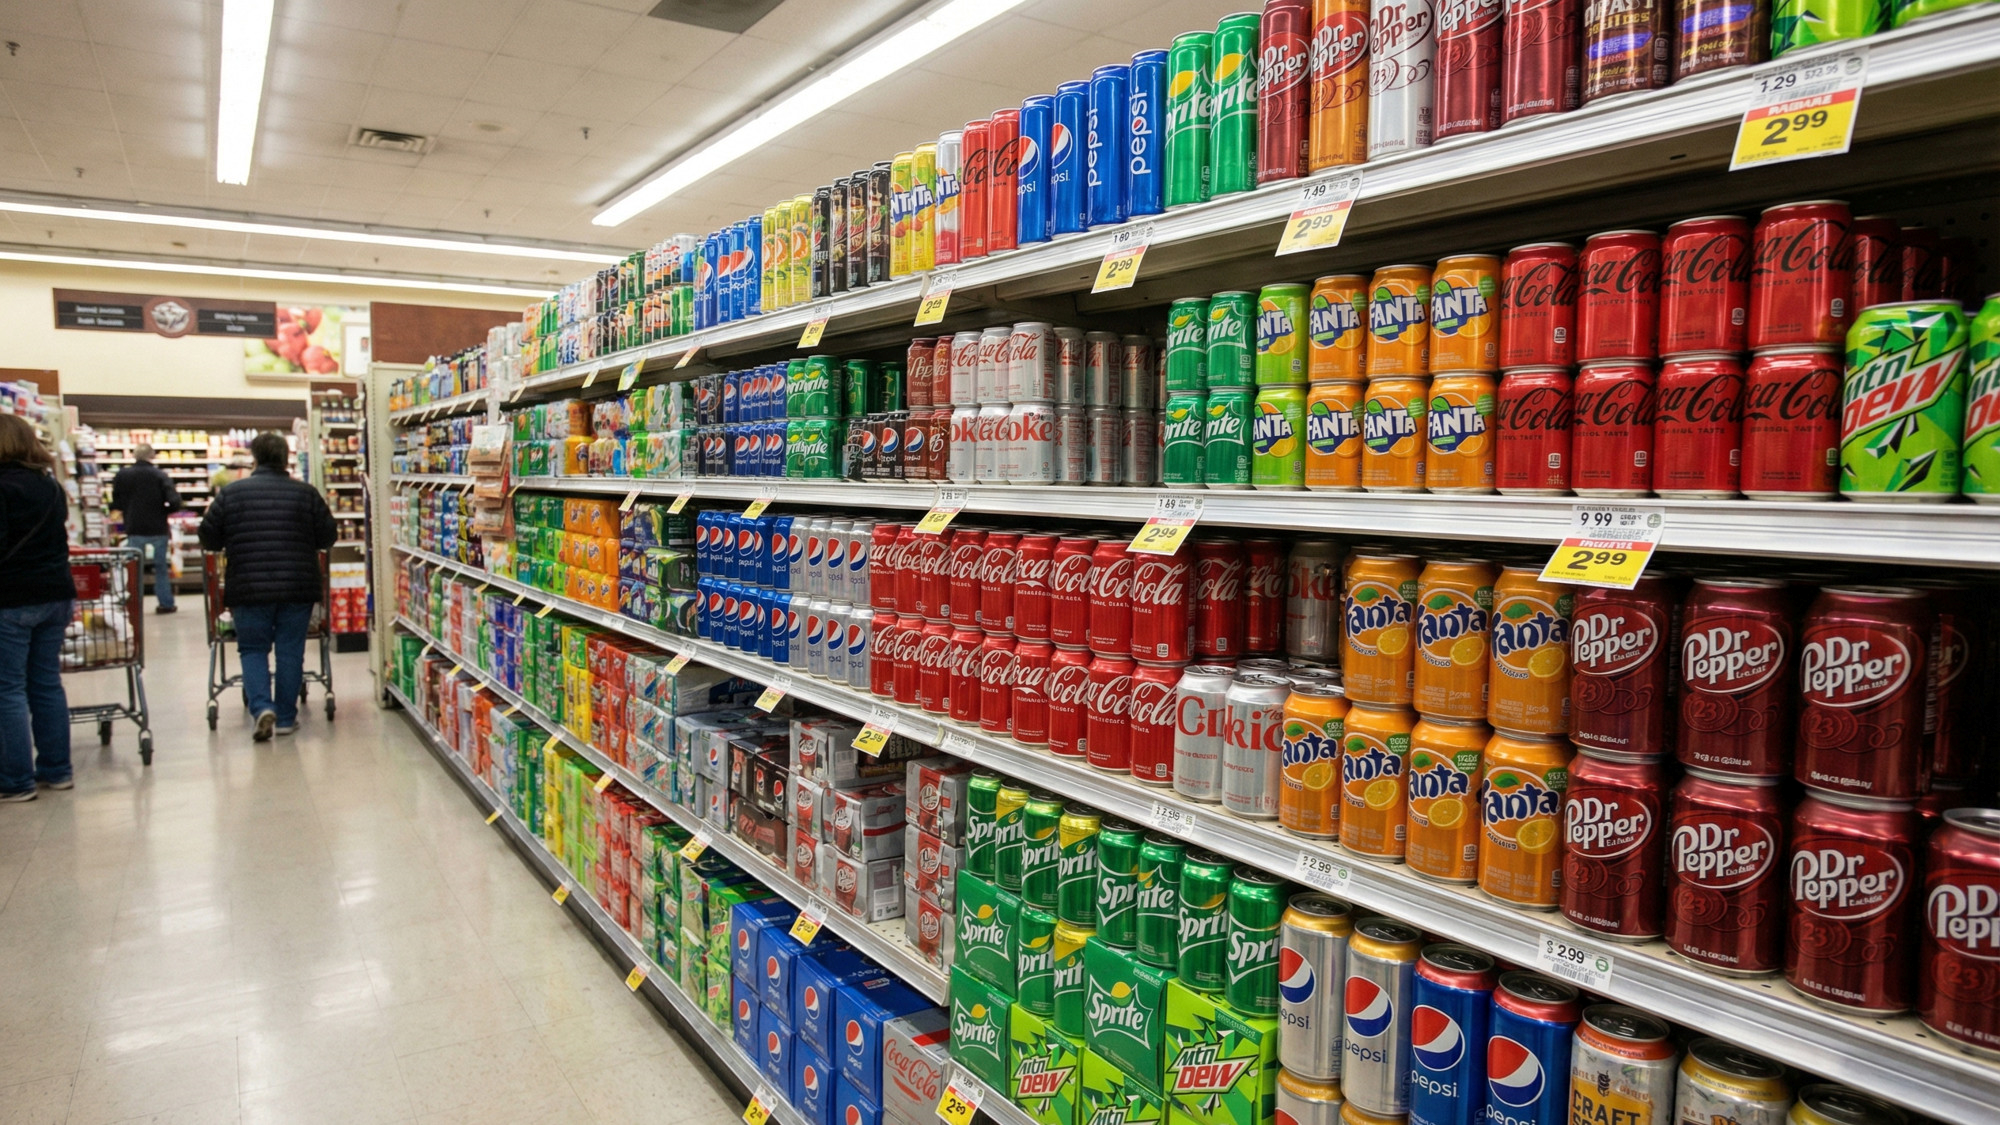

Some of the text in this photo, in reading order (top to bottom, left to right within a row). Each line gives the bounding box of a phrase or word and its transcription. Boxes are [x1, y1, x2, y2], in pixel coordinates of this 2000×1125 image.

[1378, 3, 1406, 34] Dr
[1319, 24, 1344, 51] Dr
[1264, 45, 1288, 71] Dr
[1087, 108, 1103, 187] pepsi
[1129, 91, 1153, 175] pepsi
[1572, 619, 1652, 668] Pepper
[1590, 613, 1624, 642] Dr
[1708, 627, 1751, 657] Dr
[1683, 632, 1778, 685] Pepper
[1826, 636, 1870, 668] Dr
[1802, 642, 1903, 699] Pepper
[1565, 798, 1645, 850] Pepper
[1583, 797, 1619, 825] Dr
[1673, 825, 1768, 878] Pepper
[1699, 823, 1740, 851] Dr
[1791, 850, 1895, 909] Pepper
[1819, 849, 1864, 879] Dr
[961, 916, 1004, 946] Sprite
[1089, 992, 1145, 1032] Sprite
[955, 1013, 996, 1045] Sprite
[1177, 1047, 1213, 1067] Mtn
[1411, 1069, 1459, 1098] pepsi
[1573, 1089, 1641, 1125] CRAFT
